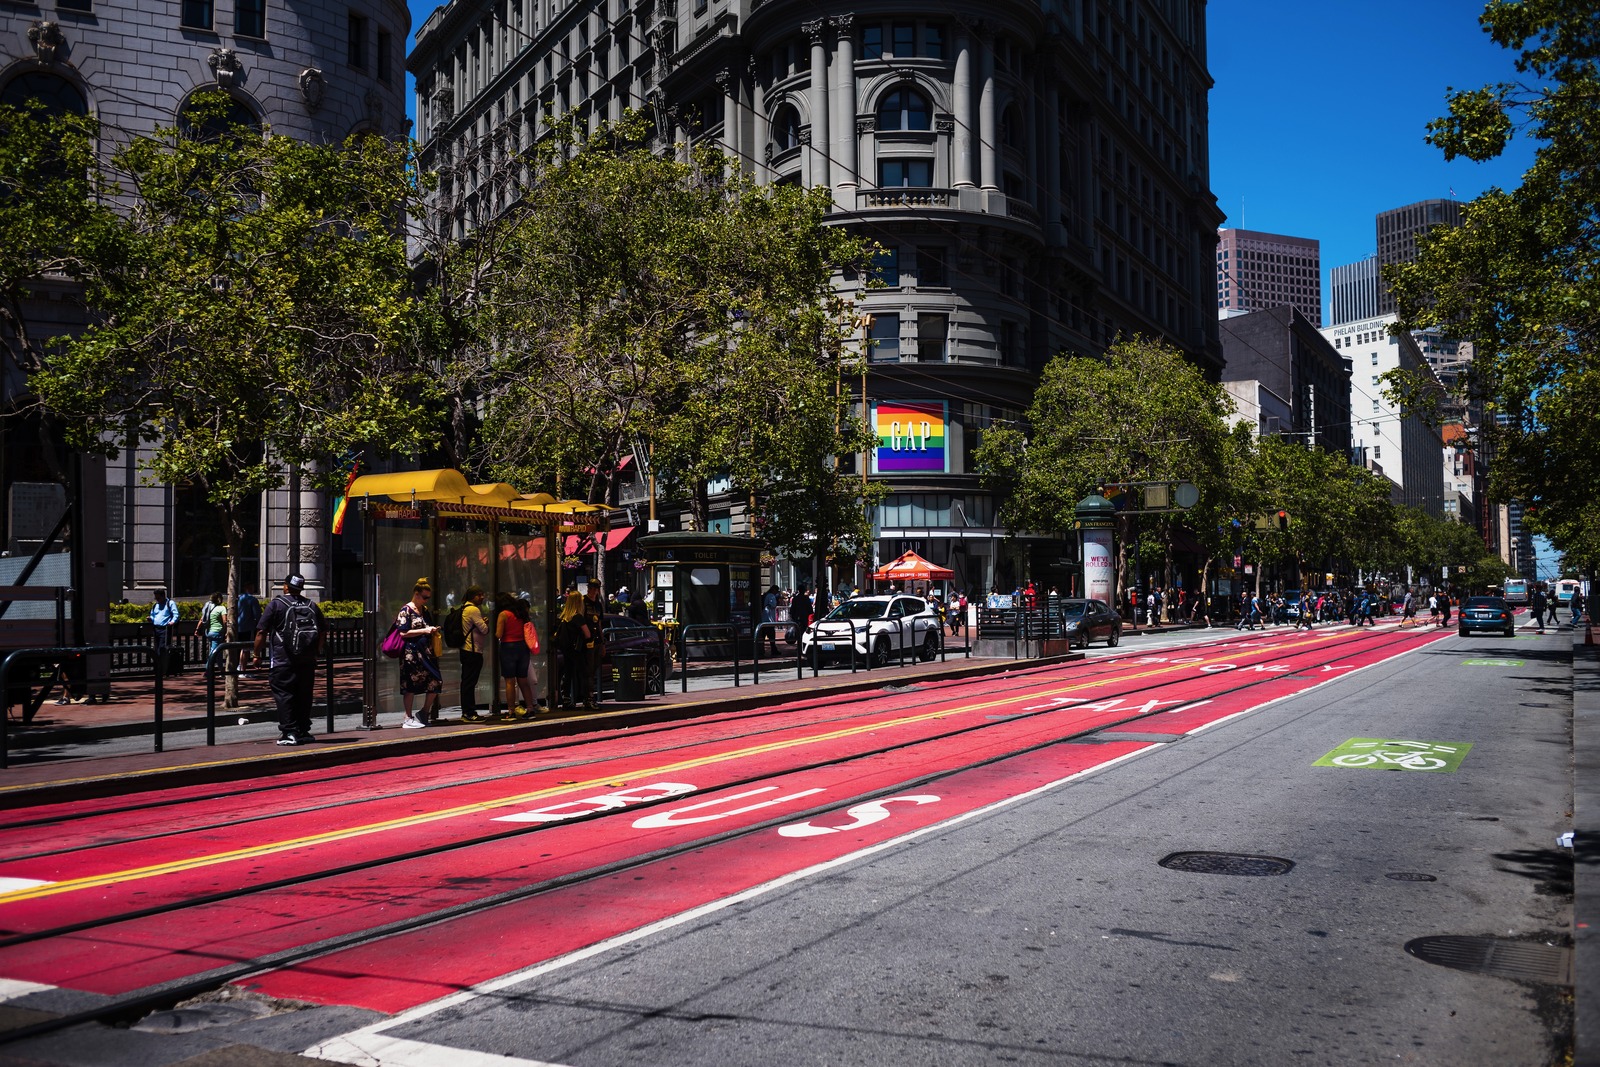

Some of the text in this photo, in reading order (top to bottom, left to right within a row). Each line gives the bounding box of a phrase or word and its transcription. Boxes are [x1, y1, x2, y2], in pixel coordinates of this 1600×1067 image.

[1333, 320, 1384, 337] PHELAN BUILDING
[891, 421, 931, 452] GAP
[398, 510, 417, 519] RAPID
[901, 541, 921, 554] GAP
[693, 551, 718, 559] TOILET
[738, 580, 750, 589] STOP
[1199, 663, 1354, 673] ONLY
[1022, 697, 1214, 714] TAXI
[489, 782, 942, 839] BUS
